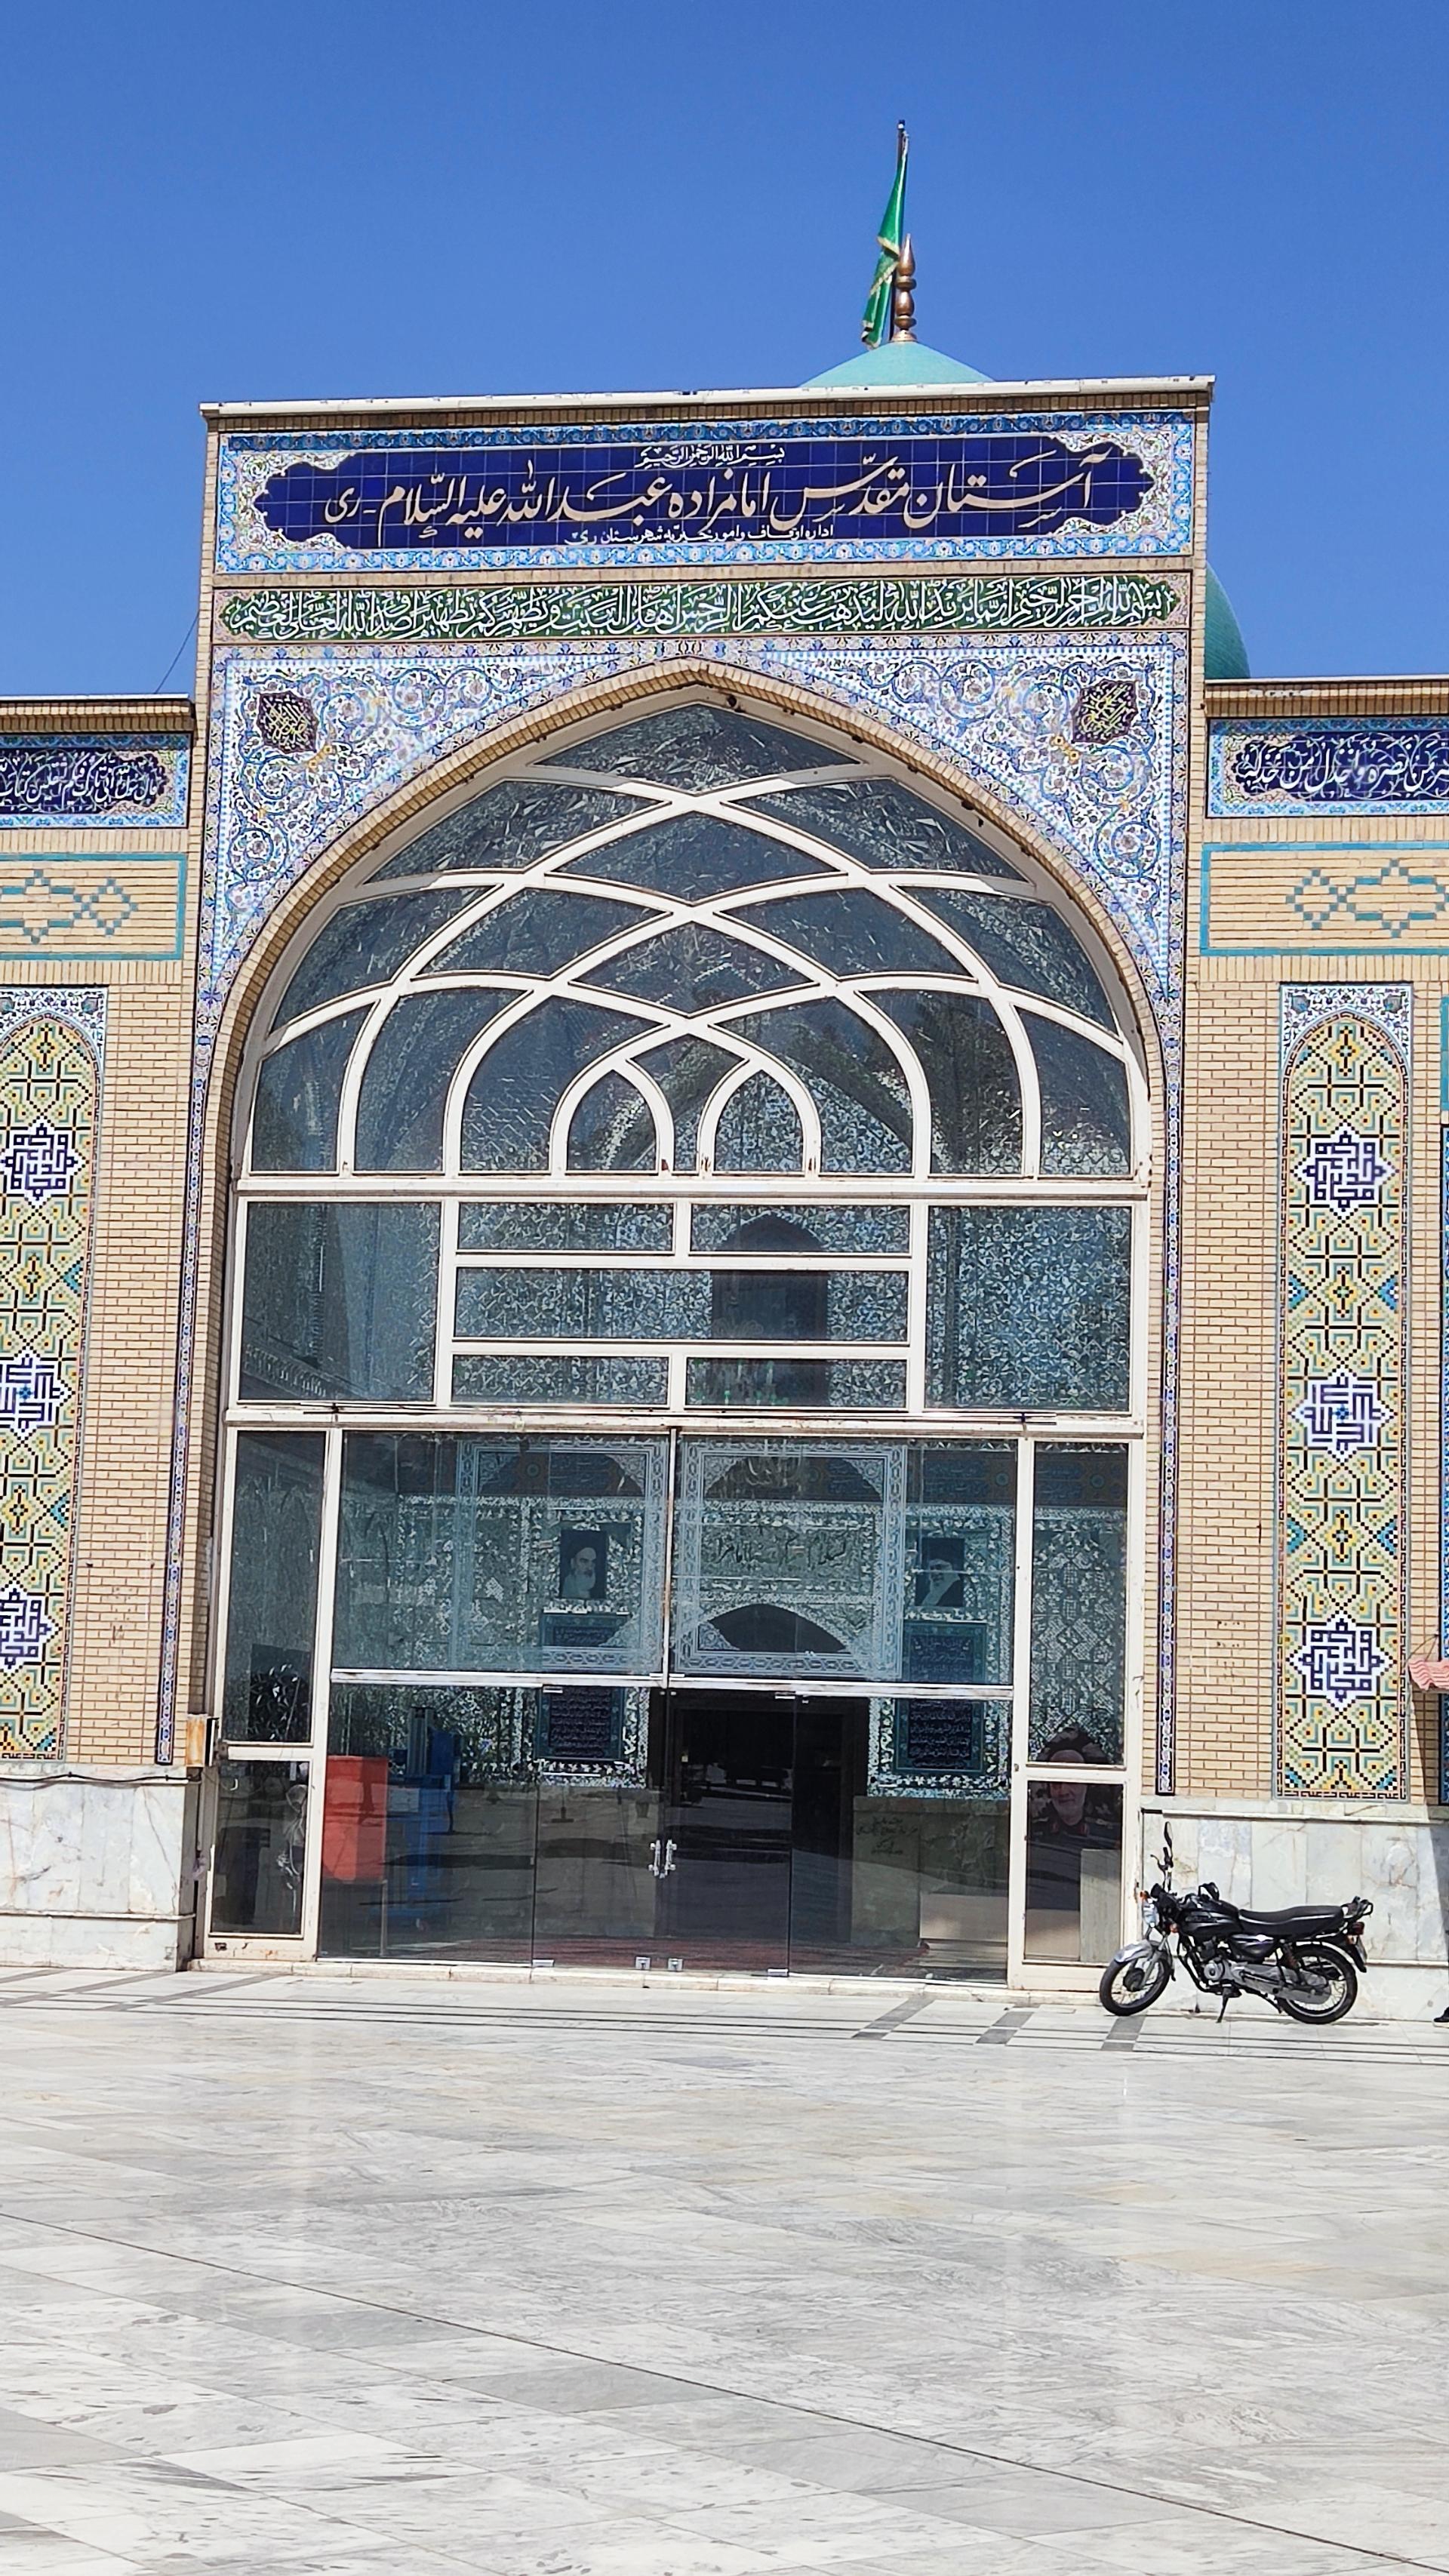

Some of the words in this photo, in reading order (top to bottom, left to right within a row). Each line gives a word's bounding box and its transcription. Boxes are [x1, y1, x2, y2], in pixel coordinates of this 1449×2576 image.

[903, 447, 1113, 529] آستان
[325, 487, 361, 523] ری
[378, 472, 467, 547] السلام
[445, 485, 507, 539] علیه
[601, 525, 663, 545] شهرستان
[663, 524, 713, 542] خیریه
[747, 523, 803, 541] اوقاف
[804, 524, 834, 541] اداره
